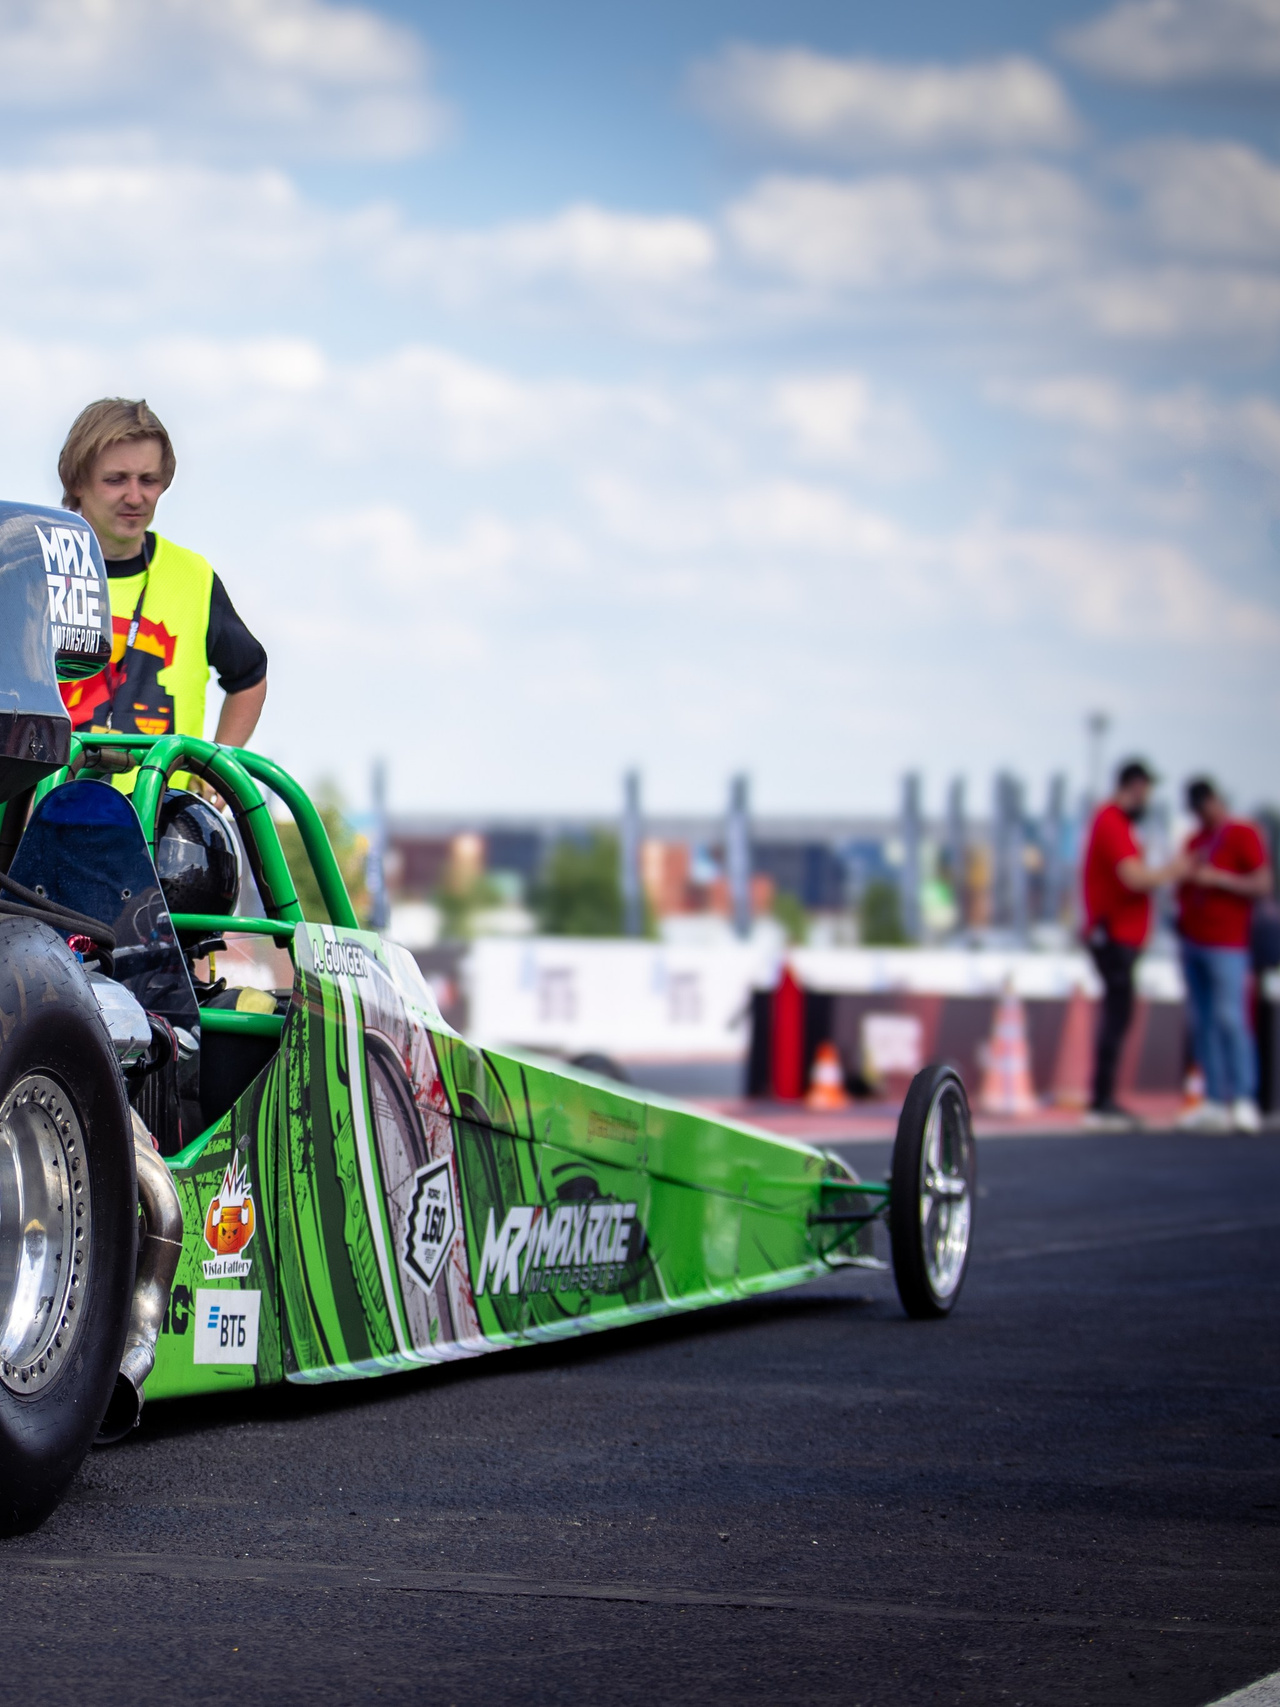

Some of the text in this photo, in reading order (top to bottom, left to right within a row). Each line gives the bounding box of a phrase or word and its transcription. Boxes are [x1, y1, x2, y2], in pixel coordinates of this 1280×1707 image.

[35, 525, 99, 579] MAX
[51, 624, 102, 654] MOTORSPORT
[323, 940, 368, 978] GUNGER
[421, 1203, 447, 1245] 160
[203, 1262, 222, 1276] Vista
[530, 1264, 625, 1293] MOTORSPORT
[220, 1314, 247, 1348] ВТБ
